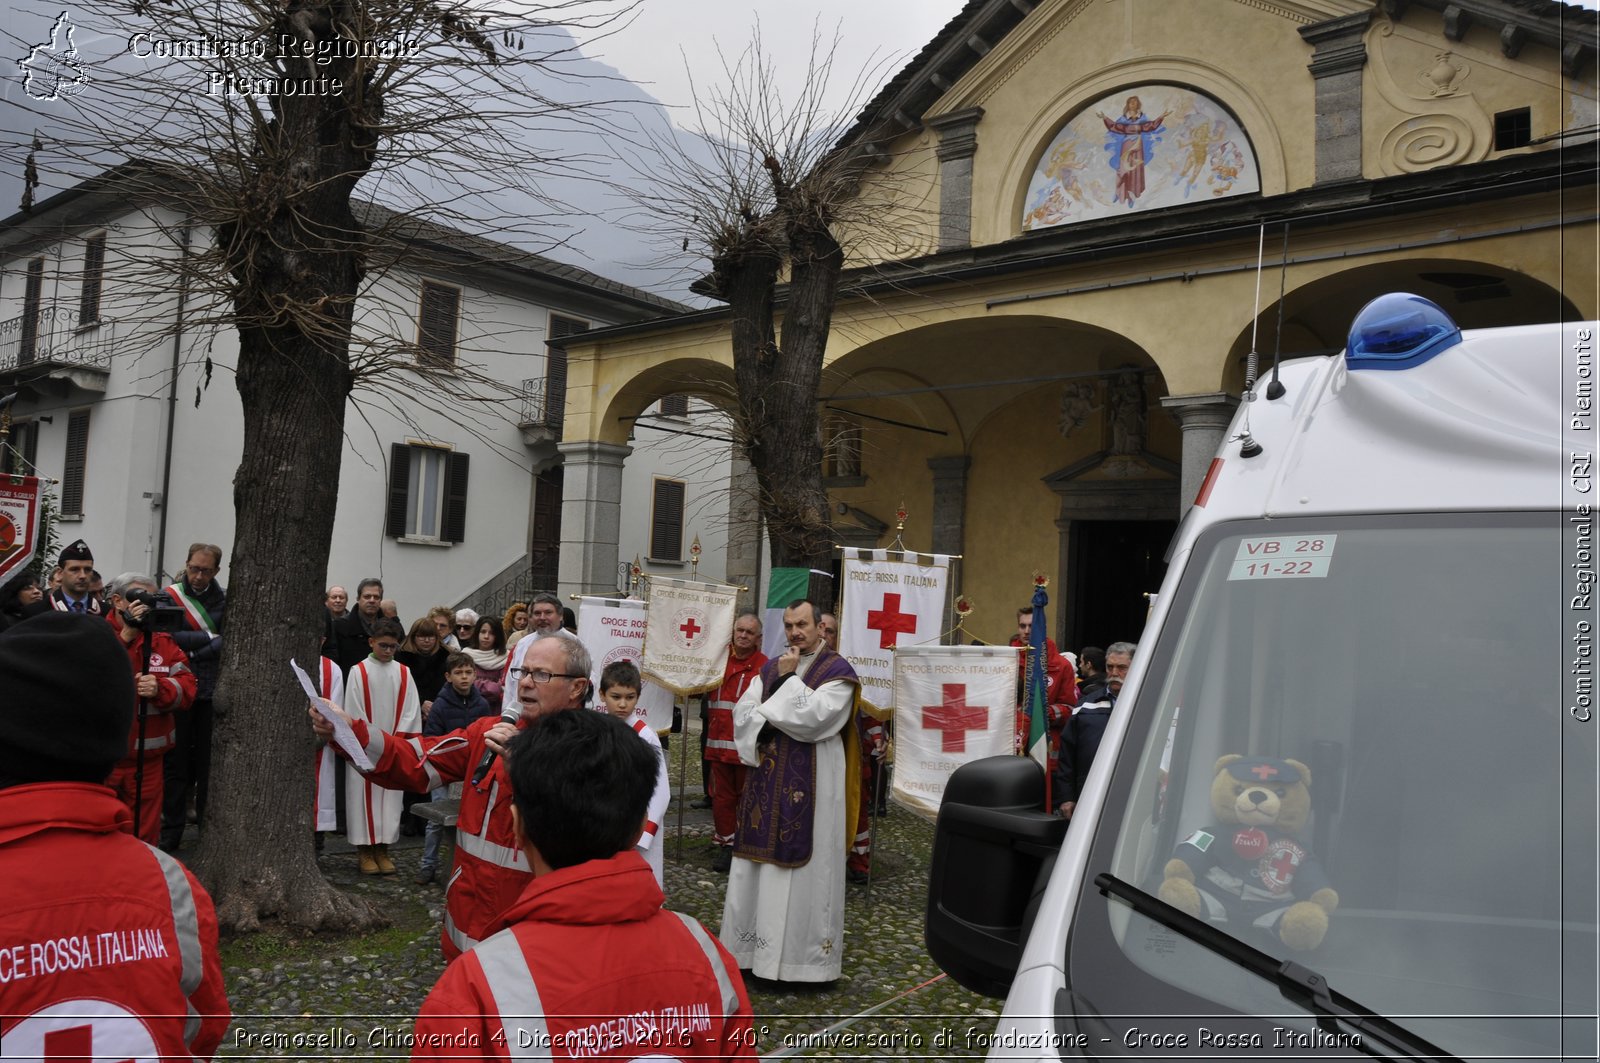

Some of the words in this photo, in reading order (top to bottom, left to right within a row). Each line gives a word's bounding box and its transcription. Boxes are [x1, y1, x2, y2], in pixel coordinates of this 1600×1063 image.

[1246, 541, 1281, 555] VB
[1294, 540, 1325, 552] 28
[1246, 561, 1313, 576] 11-22
[850, 571, 872, 582] CROCE
[876, 573, 899, 583] ROSSA
[904, 575, 937, 588] ITALIANA
[656, 589, 675, 599] CROCE
[678, 592, 700, 602] ROSSA
[703, 596, 730, 605] ITALIANA
[601, 617, 628, 627] CROCE
[610, 629, 646, 639] ITALIANA
[661, 654, 705, 665] DELEGAZIONE
[847, 656, 889, 668] COMITATO
[900, 665, 932, 674] CROCE
[935, 665, 966, 674] ROSSA
[969, 665, 1013, 674] ITALIANA
[30, 935, 93, 976] ROSSA
[97, 928, 168, 966] ITALIANA
[660, 1003, 712, 1034] ITALIANA
